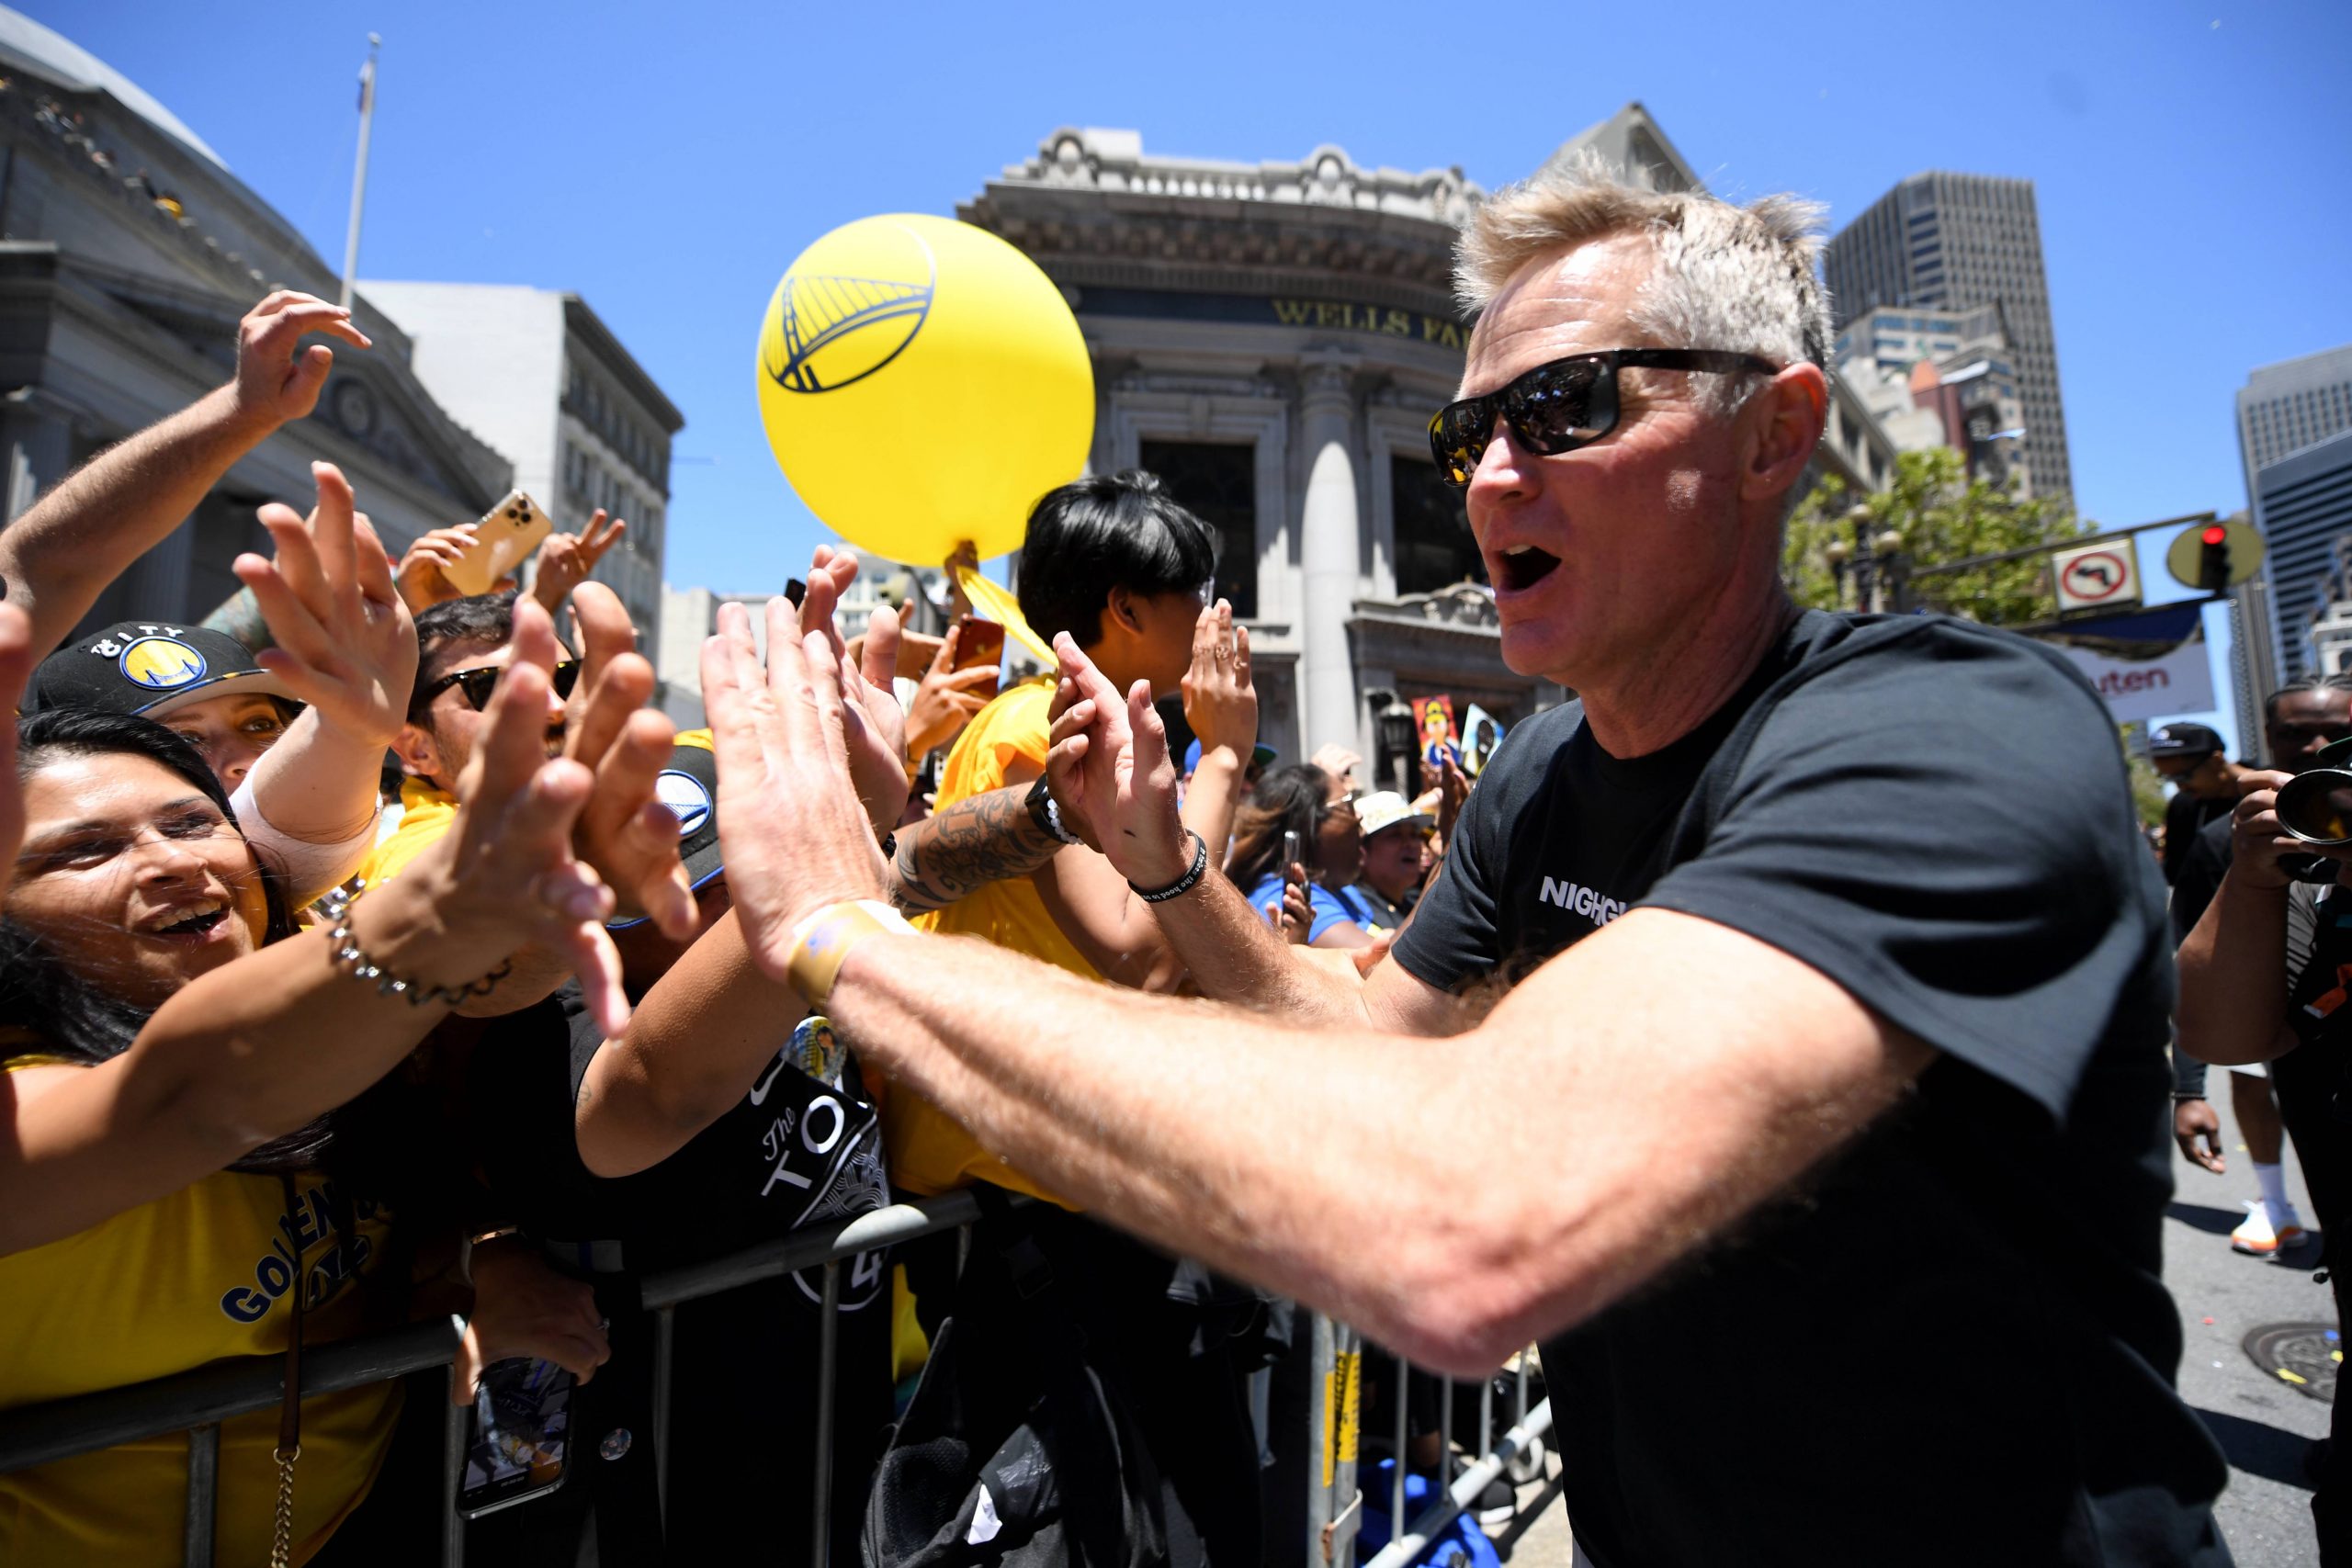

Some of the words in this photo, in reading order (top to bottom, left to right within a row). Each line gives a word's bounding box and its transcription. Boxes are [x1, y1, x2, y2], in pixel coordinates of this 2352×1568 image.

[1272, 299, 1411, 339] WELLS
[101, 626, 184, 658] CITY
[1159, 886, 1182, 899] hood
[763, 1107, 797, 1161] The
